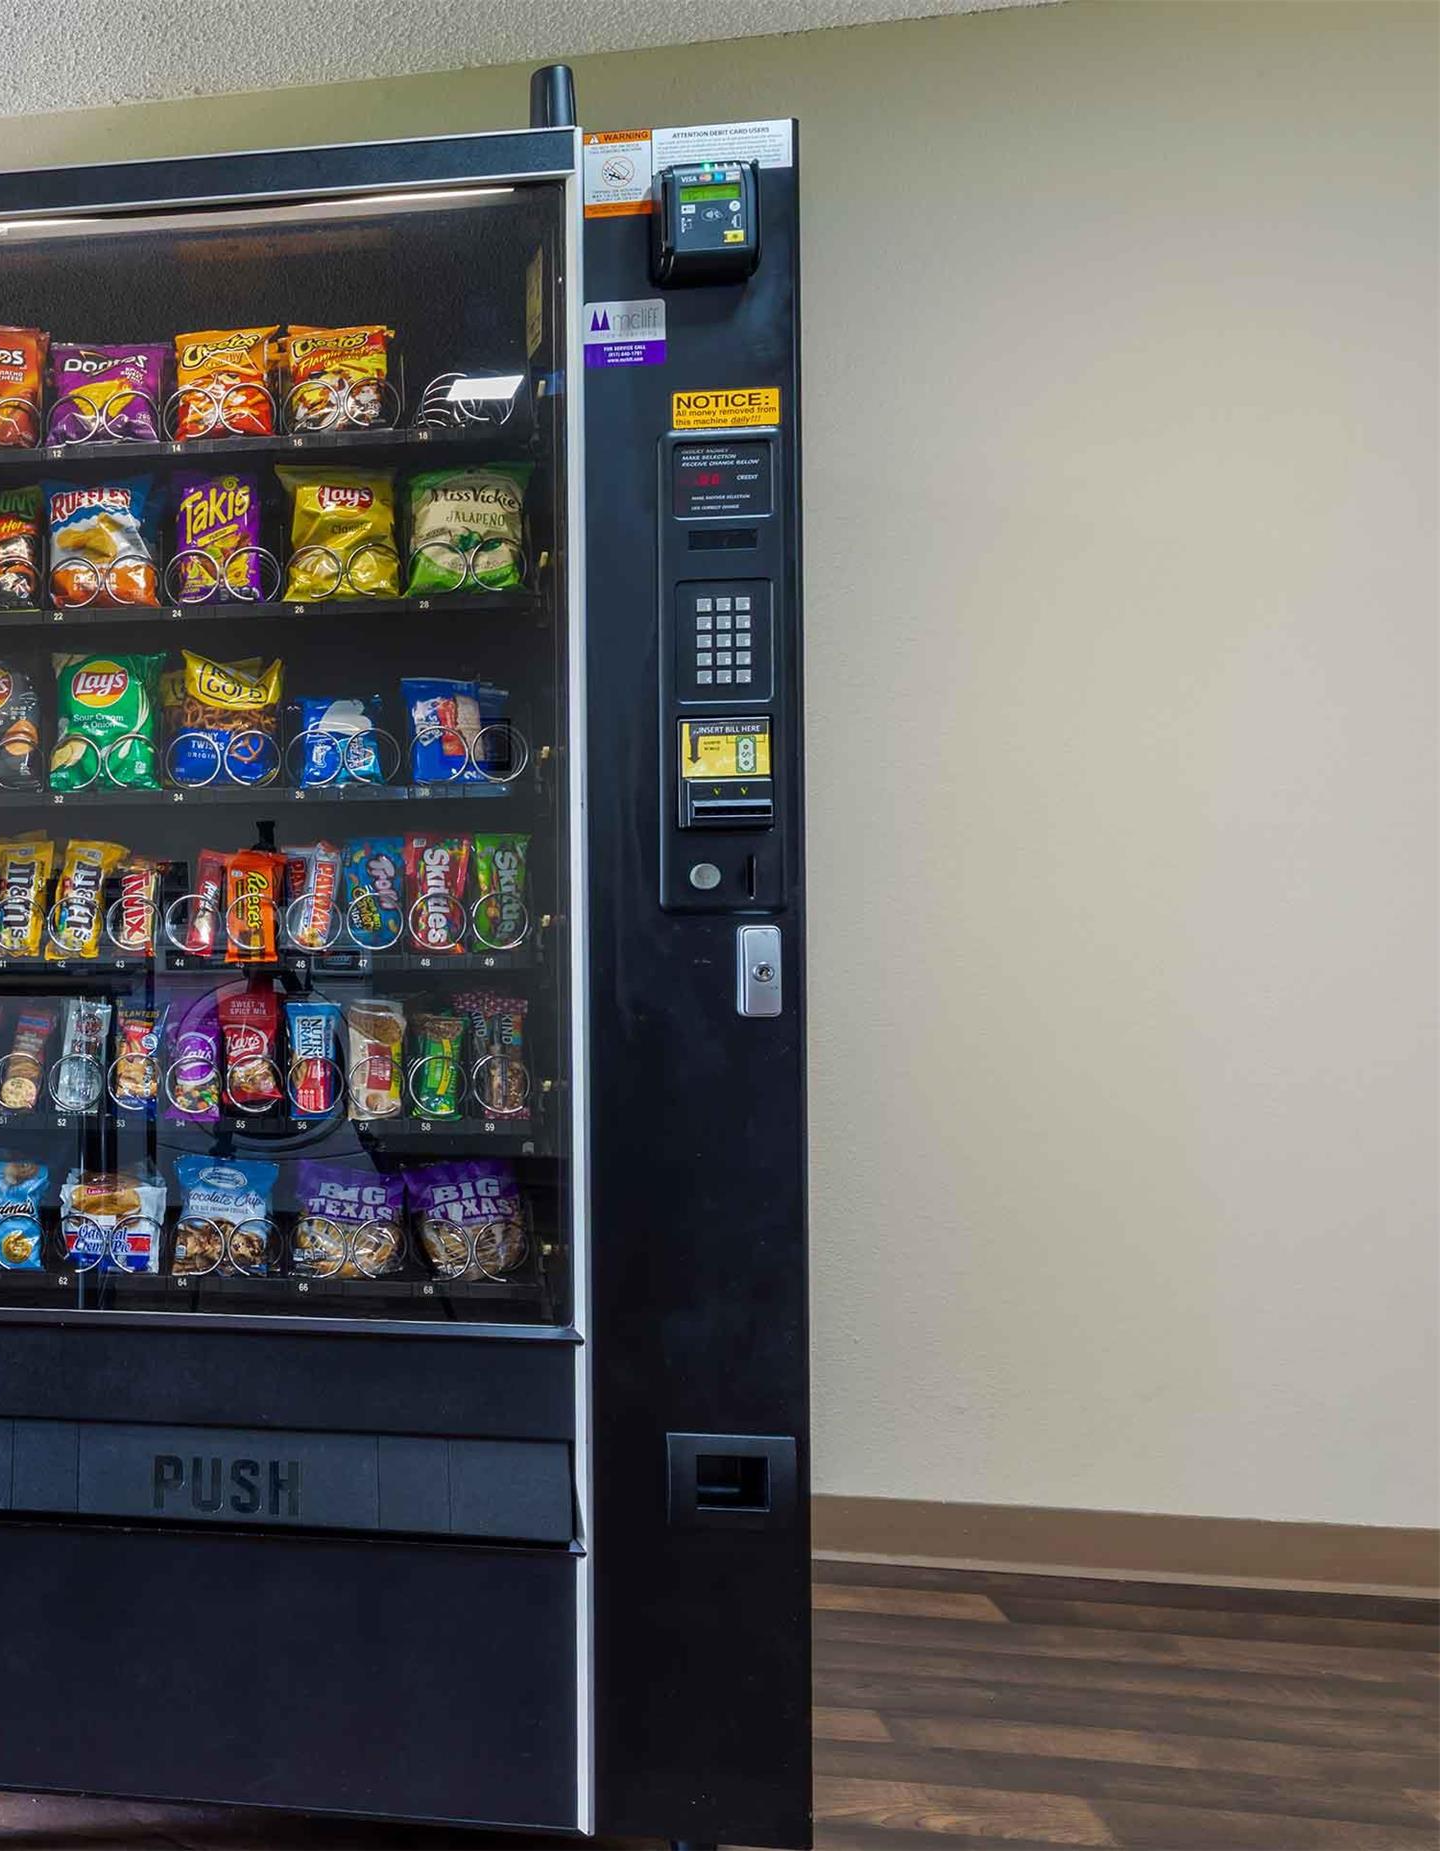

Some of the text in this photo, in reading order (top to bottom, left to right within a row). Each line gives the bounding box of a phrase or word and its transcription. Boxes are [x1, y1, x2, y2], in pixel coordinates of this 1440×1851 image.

[604, 130, 649, 142] WARNING
[672, 126, 770, 139] ATTENTION DEBIT CARD USERS
[293, 332, 368, 358] Cheetos
[182, 334, 261, 367] Cheetos
[64, 355, 148, 372] Doritos
[676, 392, 770, 409] NOTICE:
[676, 418, 690, 426] this
[694, 416, 728, 424] machine
[418, 432, 428, 440] 18
[172, 444, 180, 452] 14
[50, 487, 131, 522] RUFFLES
[180, 478, 250, 544] Takis
[446, 510, 505, 527] JALAPEÑO
[420, 600, 430, 608] 28
[294, 606, 304, 614] 26
[53, 612, 64, 620] 22
[76, 671, 126, 697] Lay's
[206, 679, 262, 699] GOLD
[74, 712, 124, 722] Sour Cream
[90, 720, 117, 729] Onion
[698, 726, 724, 734] INSERT
[742, 724, 760, 732] HERE
[174, 793, 184, 802] 34
[295, 790, 305, 799] 36
[54, 795, 64, 804] 32
[246, 871, 268, 929] Reese's
[424, 848, 450, 943] Skittles
[116, 960, 125, 968] 43
[174, 958, 184, 966] 44
[296, 960, 306, 968] 46
[358, 959, 368, 967] 47
[420, 958, 430, 966] 48
[484, 958, 494, 966] 49
[231, 1001, 256, 1009] SWEET
[230, 1008, 250, 1016] SPICY
[471, 1008, 488, 1038] KIND
[502, 1014, 513, 1044] KIND
[301, 1018, 313, 1056] GRAIN
[0, 1116, 8, 1124] 51
[57, 1118, 67, 1126] 52
[116, 1120, 126, 1128] 53
[236, 1120, 246, 1128] 55
[297, 1122, 308, 1130] 56
[360, 1122, 368, 1130] 57
[421, 1123, 431, 1131] 58
[484, 1123, 494, 1131] 59
[319, 1182, 386, 1205] BIG
[432, 1178, 500, 1205] BIG
[234, 1190, 264, 1208] Chip
[308, 1198, 394, 1220] TEXAS
[112, 1240, 132, 1252] Pie
[58, 1276, 68, 1285] 62
[178, 1278, 187, 1286] 64
[298, 1283, 308, 1292] 66
[423, 1286, 434, 1294] 68
[153, 1454, 302, 1517] PUSH
